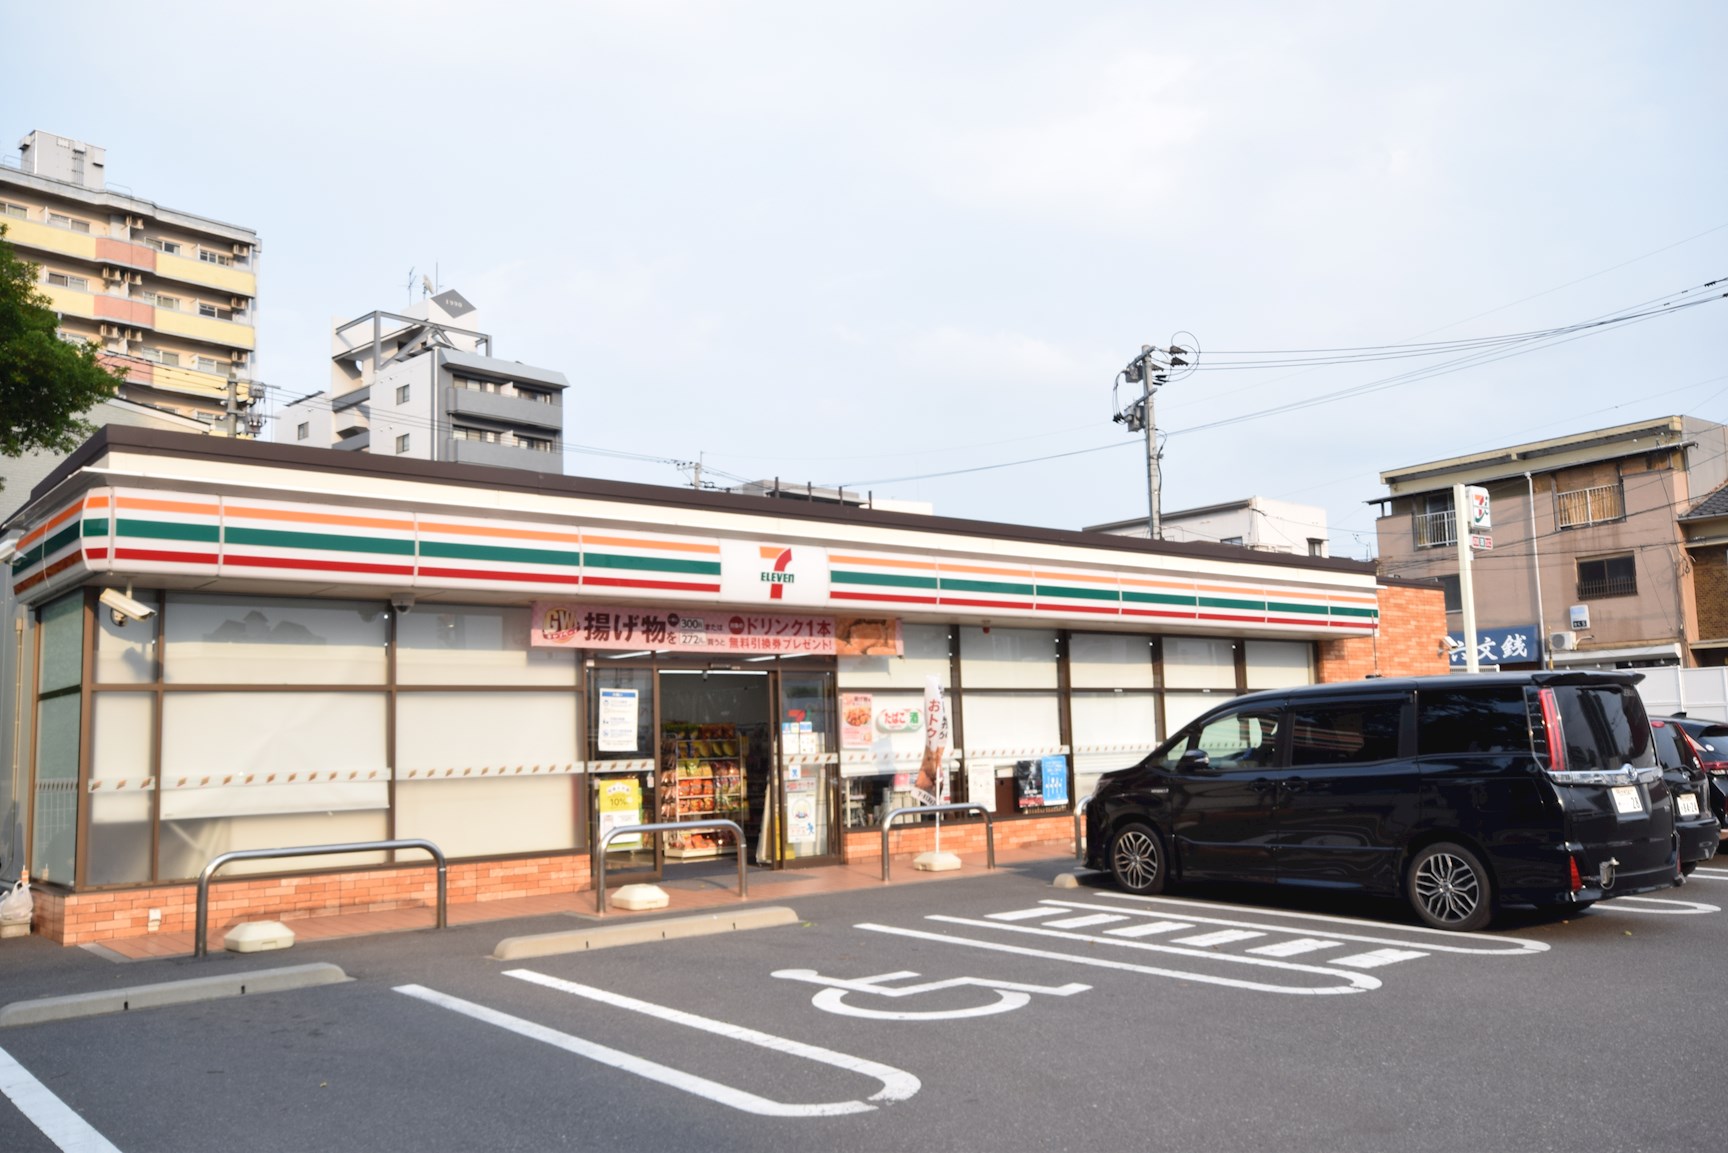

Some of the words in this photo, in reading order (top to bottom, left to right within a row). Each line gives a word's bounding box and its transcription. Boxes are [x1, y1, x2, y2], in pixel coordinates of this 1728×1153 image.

[544, 608, 578, 634] GW
[747, 617, 832, 637] ドリンク1本
[884, 712, 906, 724] たばこ
[910, 711, 919, 724] 酒
